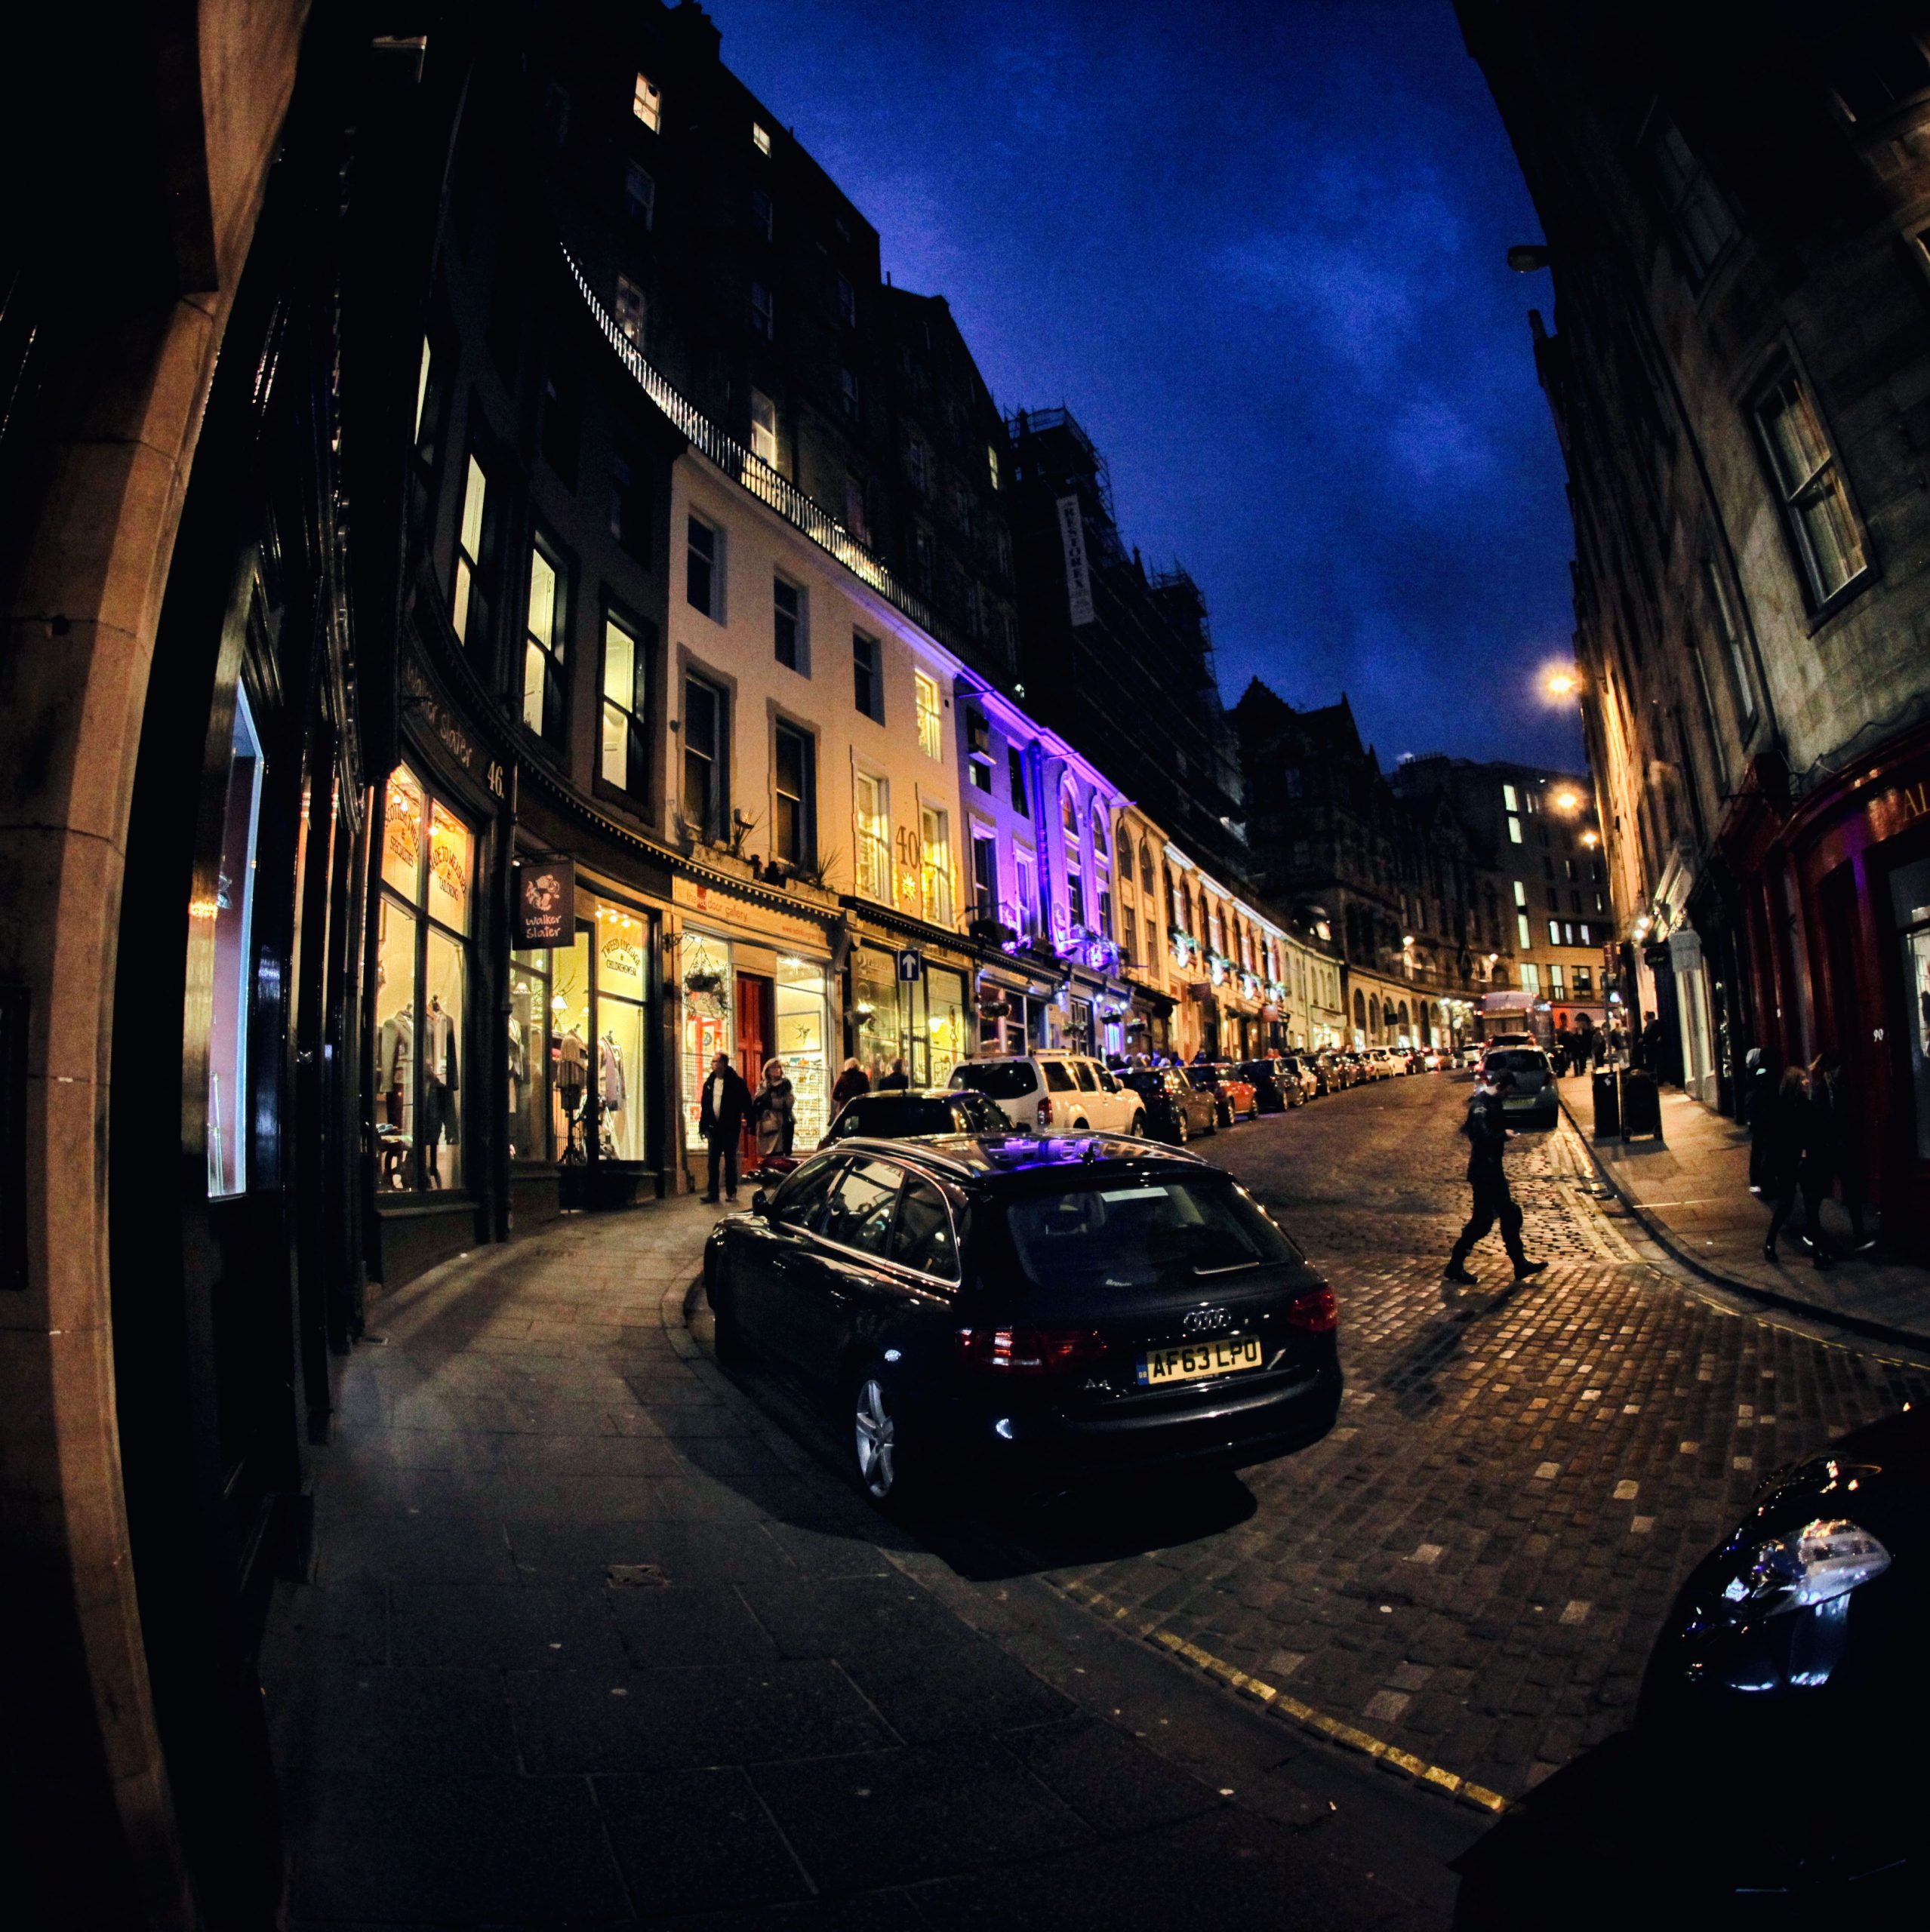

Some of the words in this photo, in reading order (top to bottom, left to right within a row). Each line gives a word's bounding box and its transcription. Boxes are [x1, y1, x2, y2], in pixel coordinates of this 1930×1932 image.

[895, 825, 918, 869] 40
[526, 925, 562, 939] Slater
[602, 938, 620, 958] TWEED
[1873, 1028, 1884, 1043] 90
[1153, 1346, 1211, 1378] AF63
[1215, 1339, 1257, 1367] LPO
